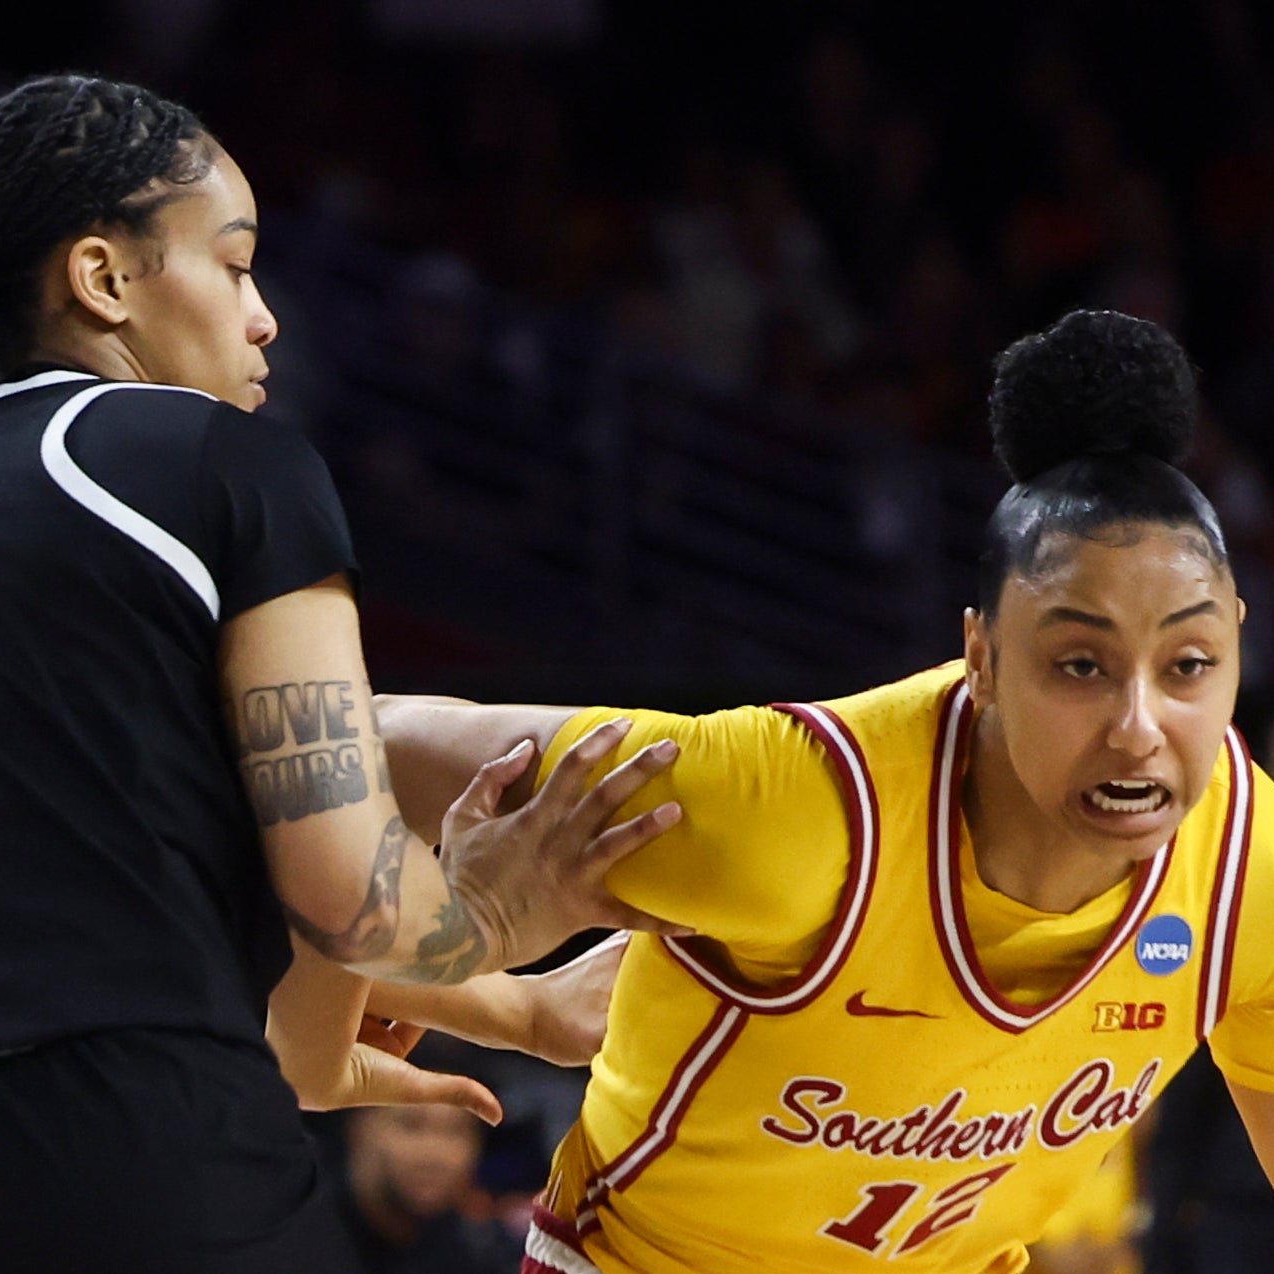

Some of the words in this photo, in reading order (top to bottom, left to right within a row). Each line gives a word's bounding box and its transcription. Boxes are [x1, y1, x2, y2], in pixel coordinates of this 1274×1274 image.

[1141, 942, 1189, 961] NCAA
[762, 1076, 1036, 1163] Southern
[1038, 1058, 1163, 1150] Cal
[818, 1163, 1018, 1261] 12
